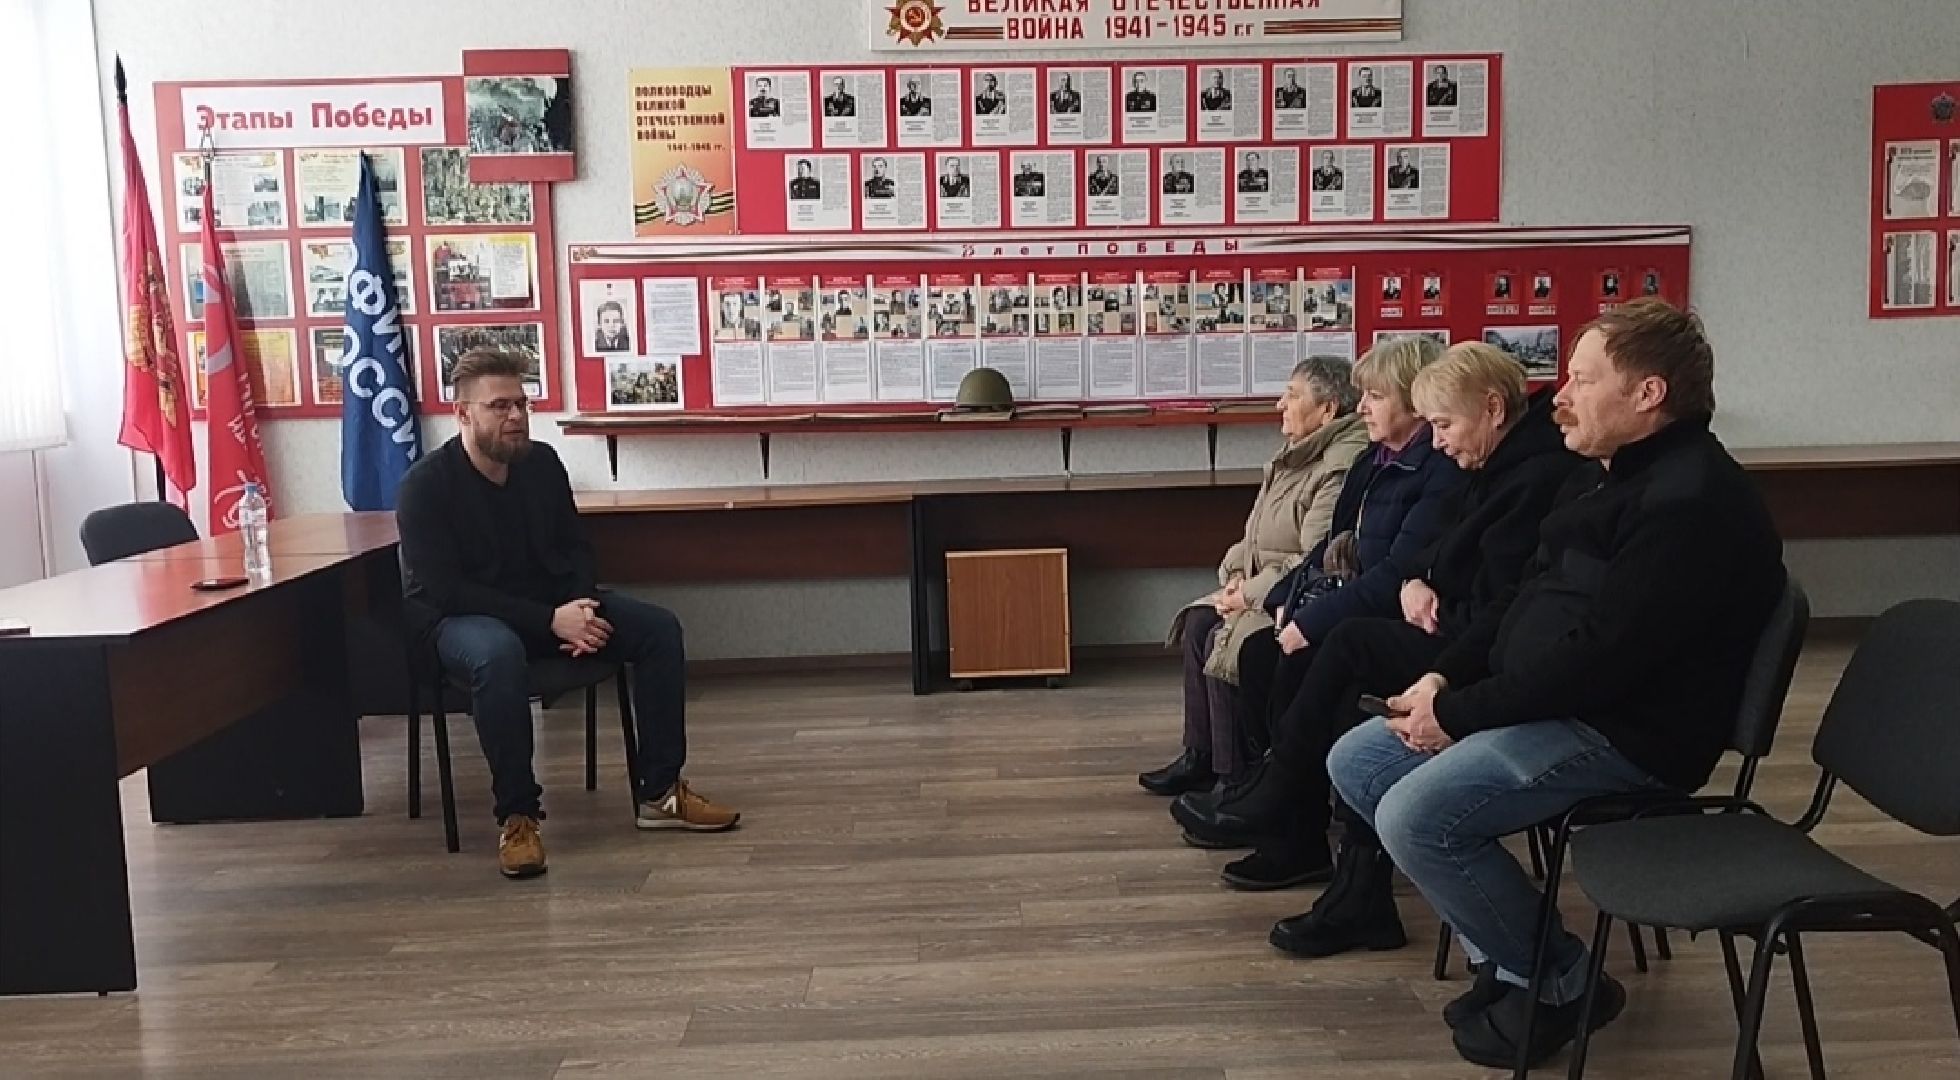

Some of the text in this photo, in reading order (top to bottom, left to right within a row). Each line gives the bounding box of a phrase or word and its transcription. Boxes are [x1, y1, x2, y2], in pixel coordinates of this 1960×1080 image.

[1007, 14, 1084, 39] ВОЙНА
[635, 85, 712, 98] ПОЛКОВОДЦЫ
[636, 98, 686, 111] ВЕЛИКОЙ
[196, 101, 432, 130] Этапы Победы
[637, 112, 725, 126] ОТЕЧЕСТВЕННОЙ
[637, 128, 676, 140] ВОЙНЫ
[1077, 240, 1238, 255] ПОБЕДЫ
